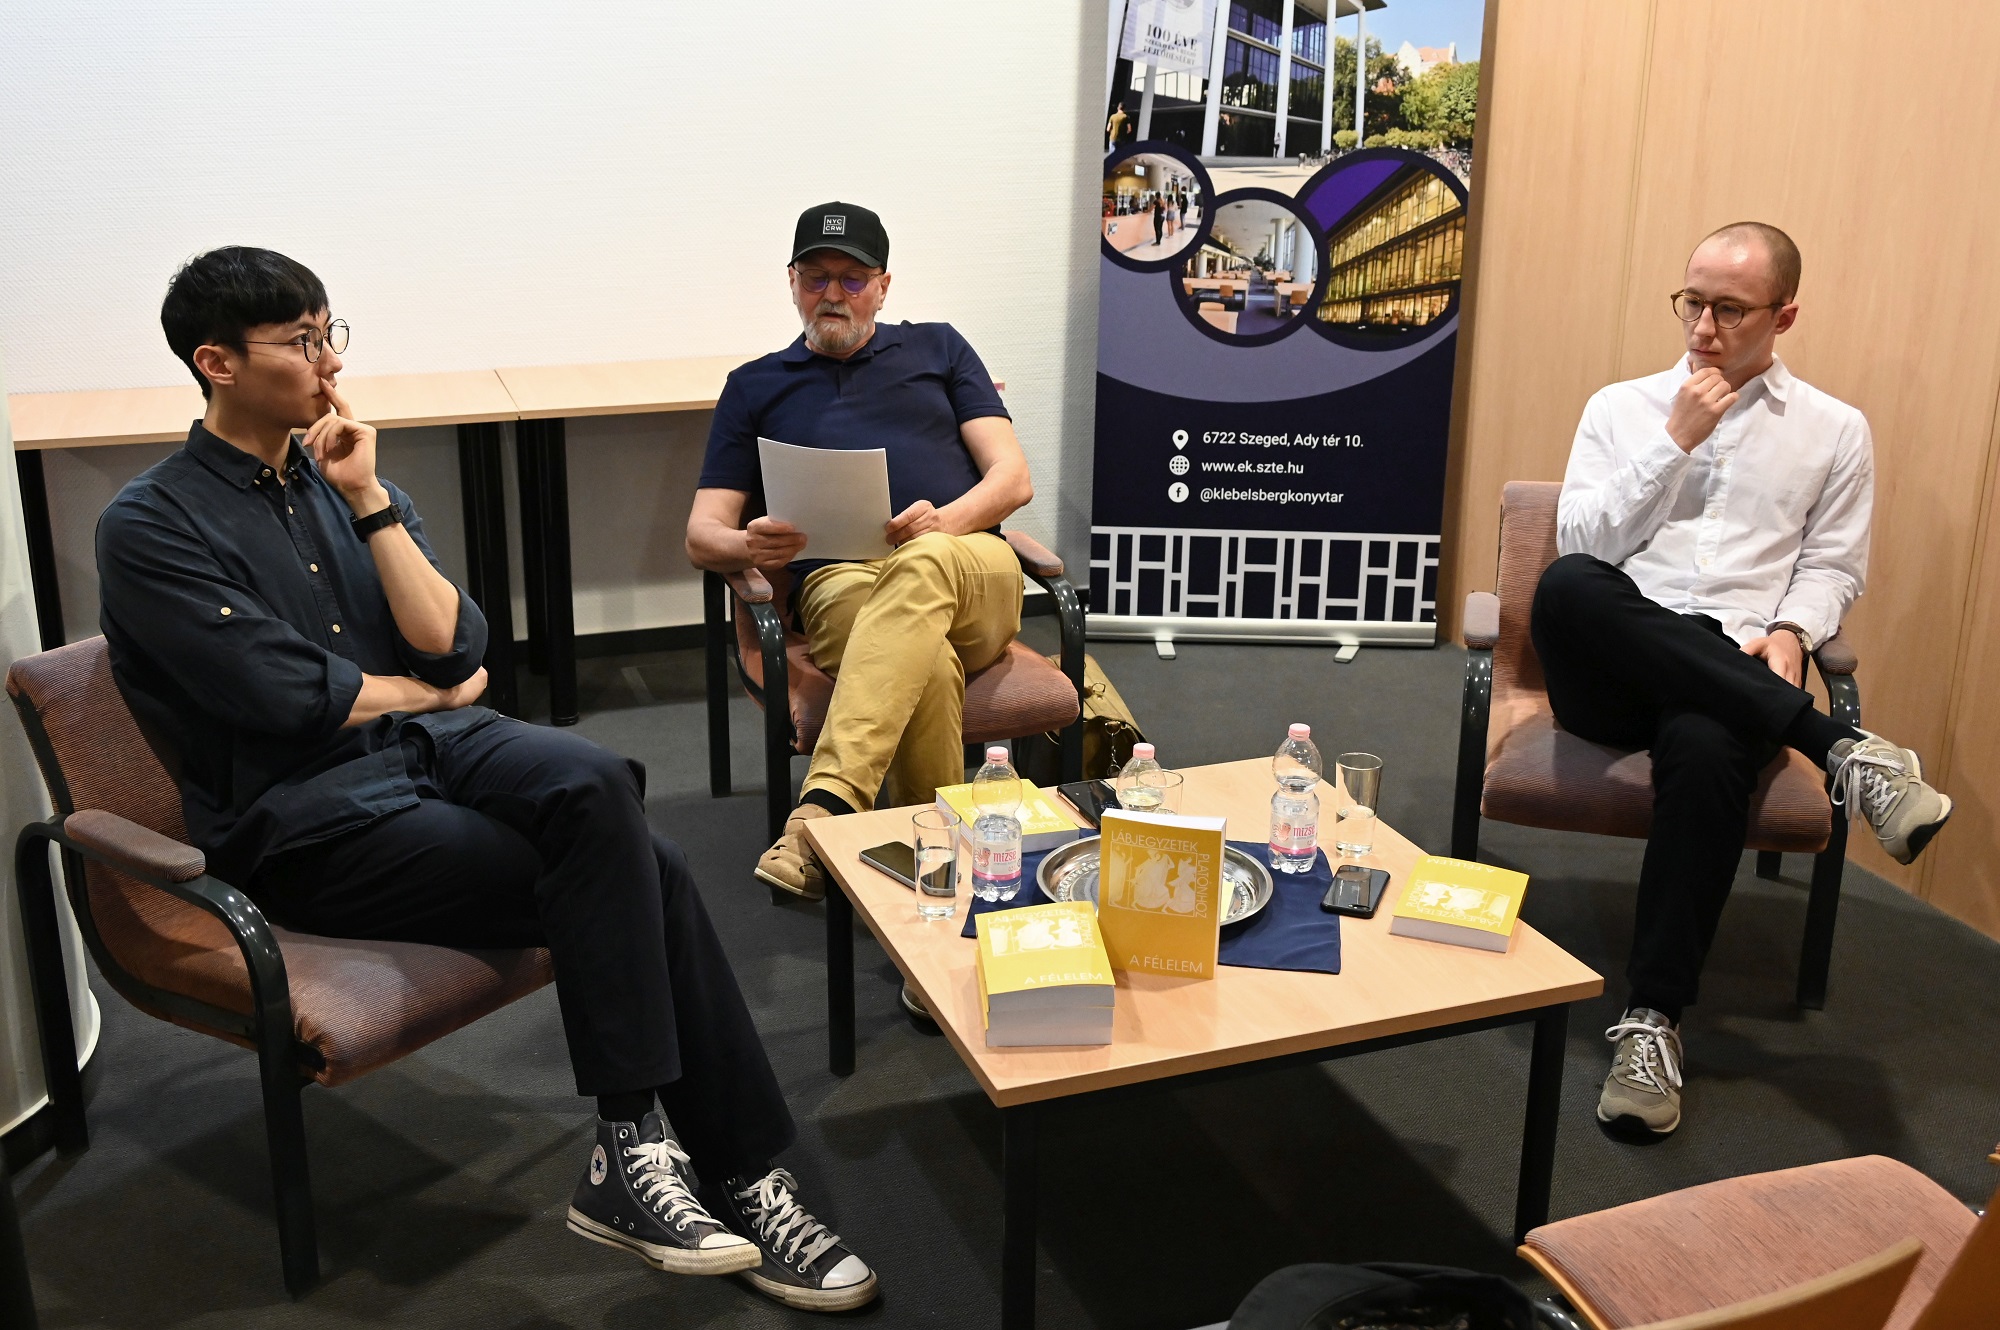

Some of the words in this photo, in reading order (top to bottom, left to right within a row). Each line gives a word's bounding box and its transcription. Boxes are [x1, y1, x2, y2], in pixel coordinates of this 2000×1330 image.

[1147, 24, 1171, 42] 100
[1203, 432, 1236, 445] 6722
[1239, 432, 1291, 448] Szeged,
[1294, 434, 1319, 449] Ady
[1322, 434, 1341, 447] tér
[1345, 435, 1364, 448] 10.
[1201, 461, 1304, 474] www.ek.szte.hu
[1200, 487, 1344, 505] @klebelsbergkonyvtar
[1111, 829, 1199, 852] LÁBJEGYZETEK
[993, 851, 1017, 862] mizse
[1195, 853, 1210, 918] PLATÓNHOZ
[1129, 954, 1140, 966] A
[1144, 955, 1203, 973] FÉLELEM
[1024, 977, 1036, 985] A
[1040, 972, 1103, 983] FÉLELEM
